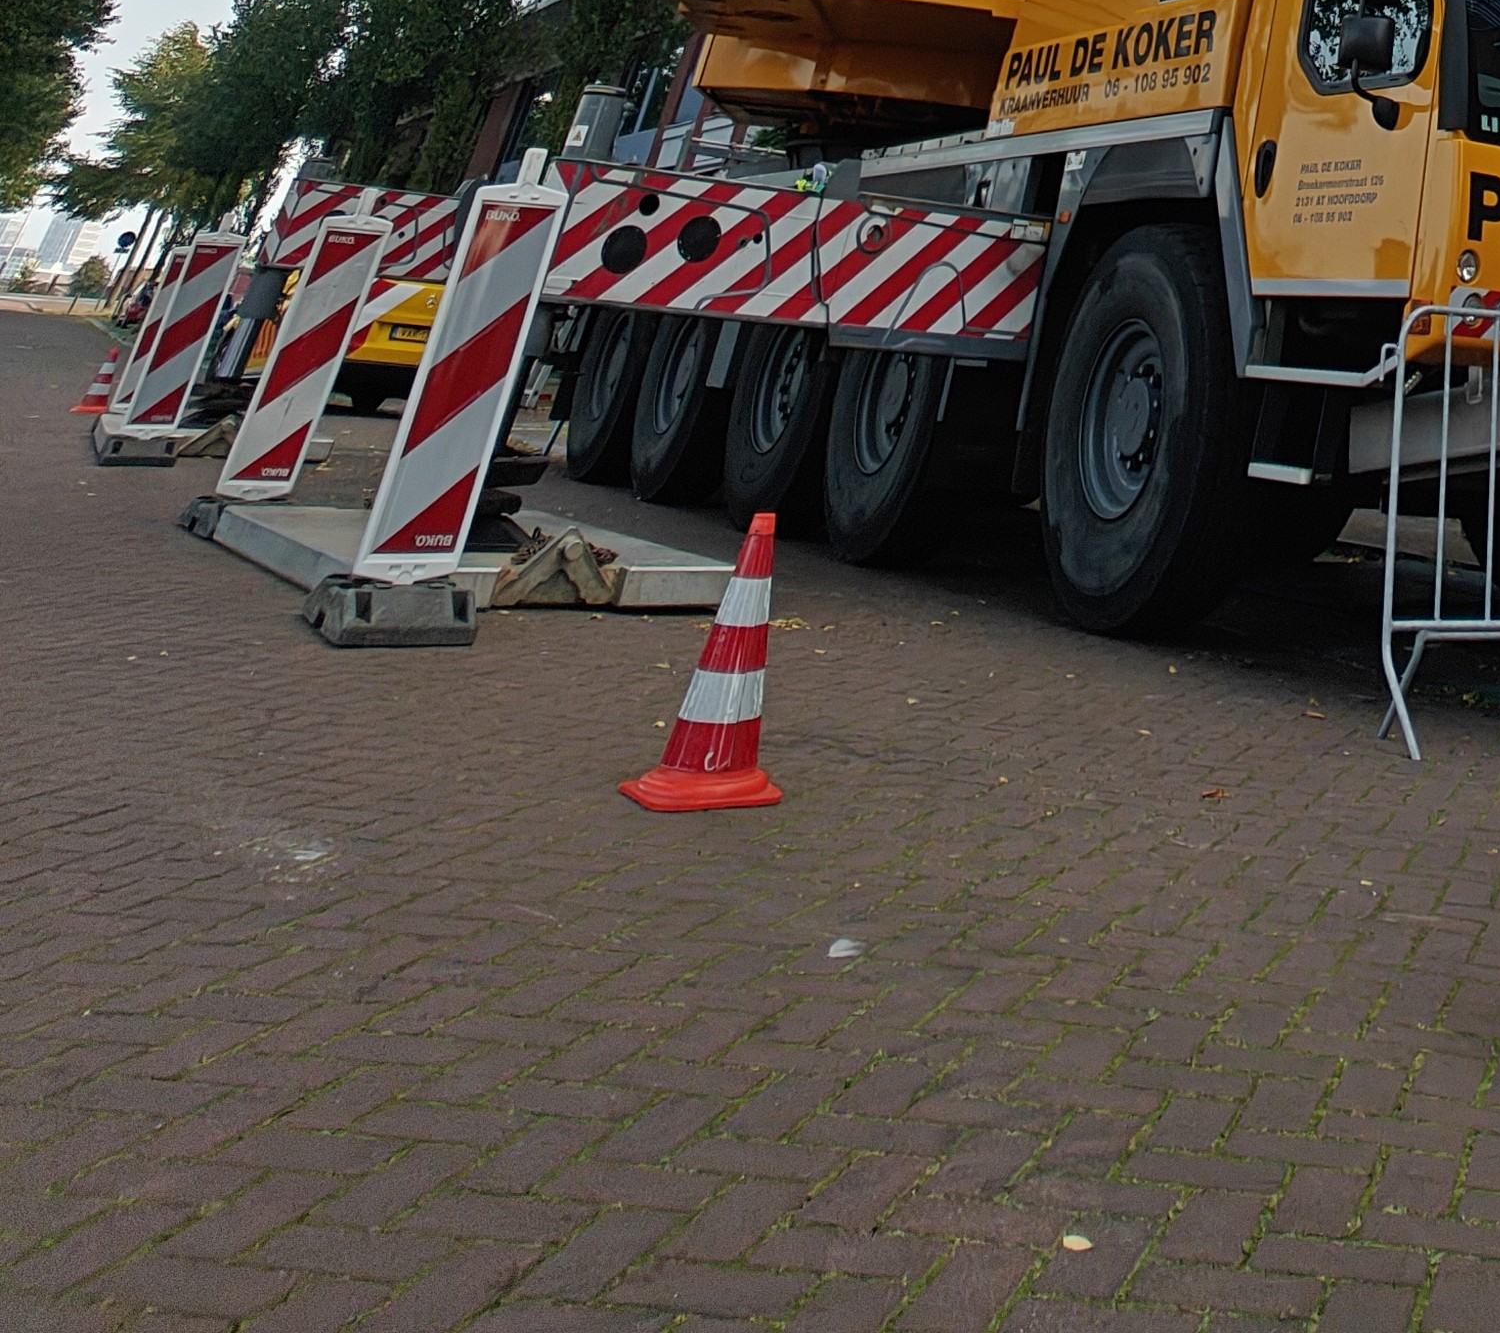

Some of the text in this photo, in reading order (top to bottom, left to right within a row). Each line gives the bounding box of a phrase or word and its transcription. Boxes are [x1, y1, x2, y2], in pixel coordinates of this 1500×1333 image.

[1004, 9, 1218, 91] PAUL DE KOKER
[999, 83, 1090, 116] KRAANVERHUUR
[1104, 78, 1120, 99] 06
[1133, 73, 1157, 95] 108
[1162, 66, 1179, 89] 95
[1183, 62, 1212, 85] 902
